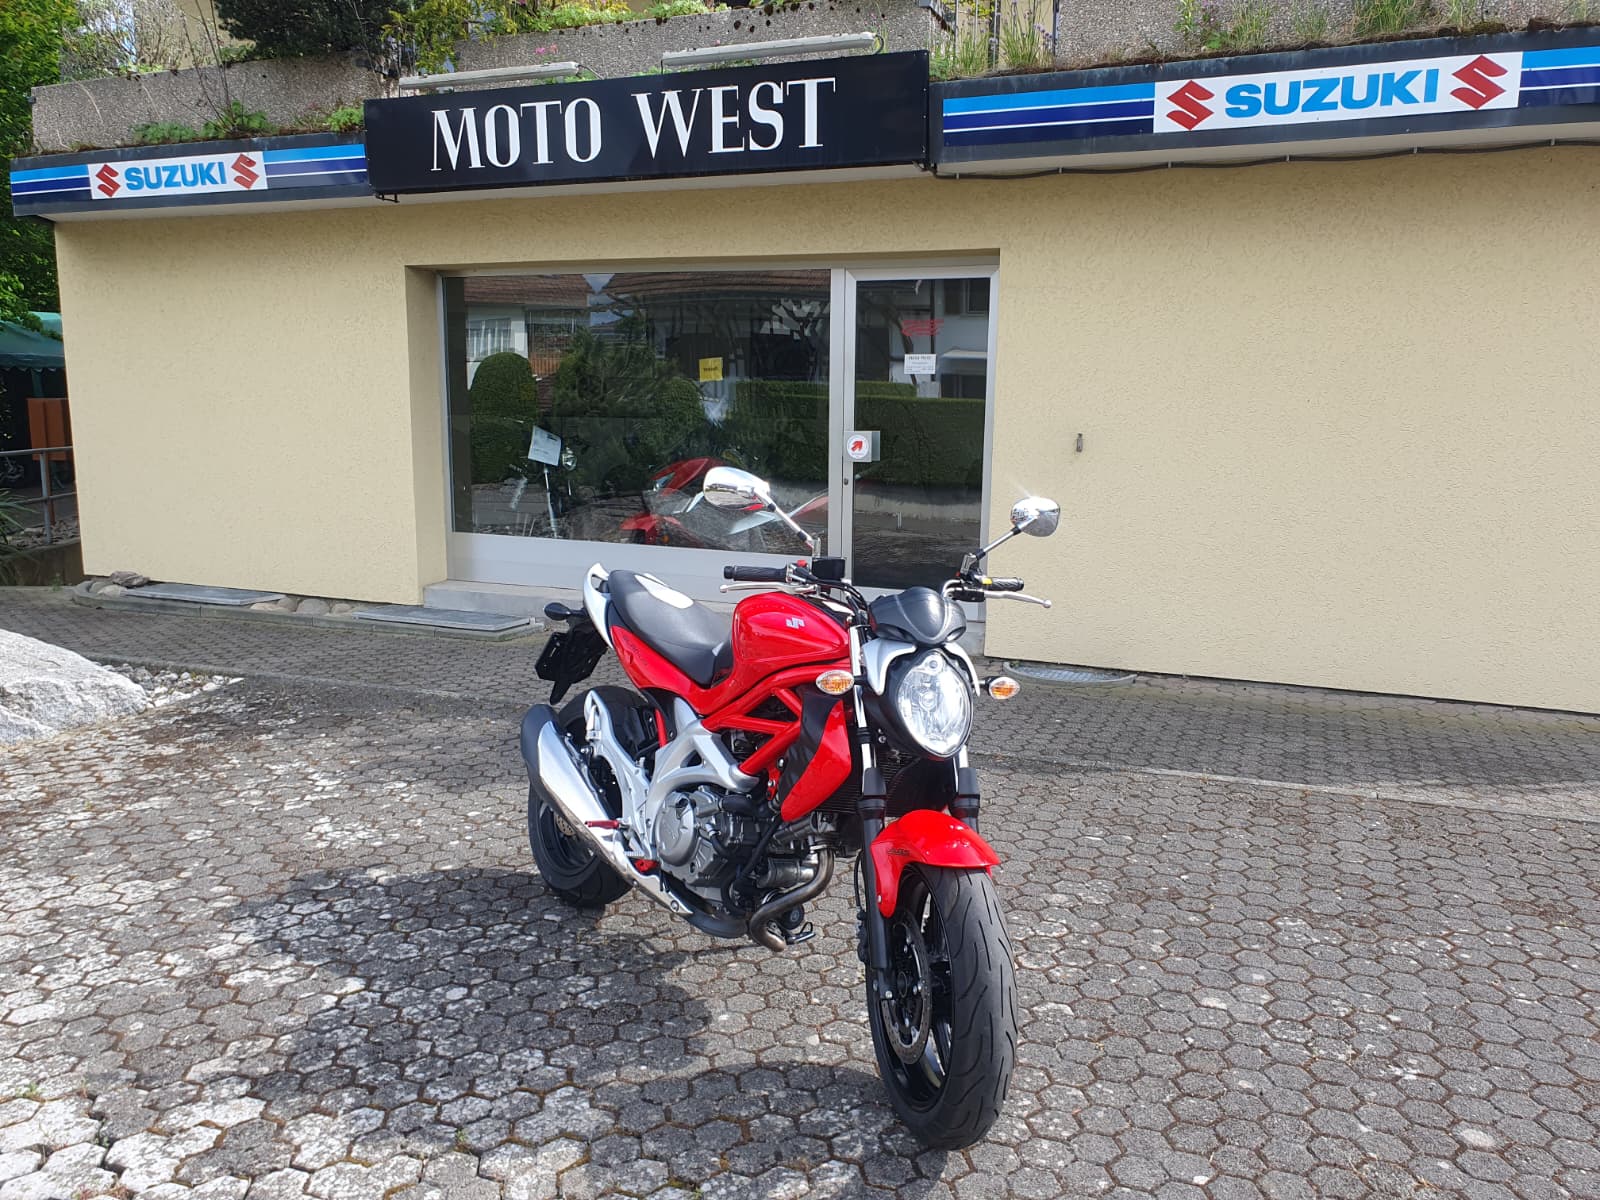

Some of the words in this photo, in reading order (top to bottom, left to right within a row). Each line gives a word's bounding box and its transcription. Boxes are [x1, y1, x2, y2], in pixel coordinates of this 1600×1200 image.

[1225, 68, 1440, 118] SUZUKI
[430, 97, 602, 171] MOTO
[630, 77, 836, 159] WEST
[124, 162, 227, 191] SUZUKI
